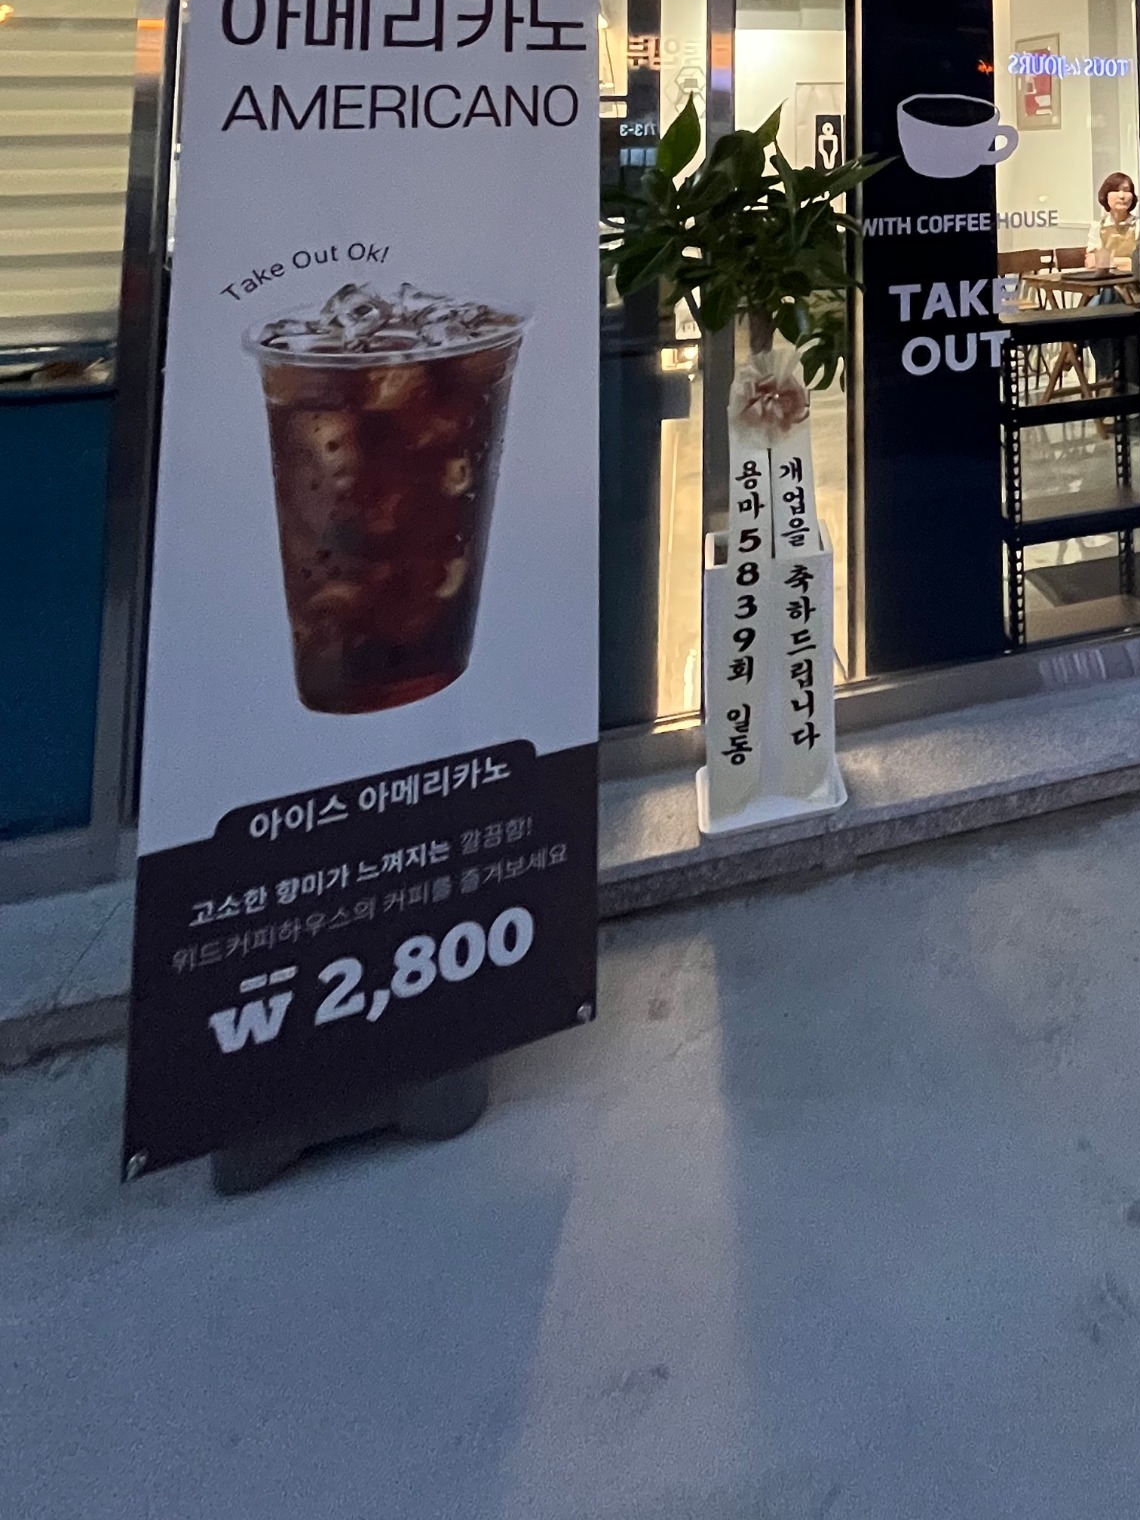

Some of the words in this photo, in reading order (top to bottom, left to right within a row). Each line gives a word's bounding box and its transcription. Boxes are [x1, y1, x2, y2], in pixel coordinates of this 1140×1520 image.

[221, 84, 580, 132] AMERICANO
[862, 216, 912, 237] WITH
[917, 212, 992, 235] COFFEE
[996, 209, 1059, 230] HOUSE
[220, 262, 286, 301] Take
[292, 245, 338, 269] Out
[347, 242, 390, 264] Ok!
[888, 277, 1020, 322] TAKE
[902, 329, 1011, 376] OUT
[779, 456, 811, 547] 개업을
[784, 564, 821, 751] 축하드립니다
[721, 703, 754, 766] 일동
[249, 795, 349, 842] 아이스
[358, 755, 512, 815] 아메리카노
[188, 883, 268, 927] 고소한
[275, 863, 350, 905] 향미가
[356, 840, 450, 883] 느껴지는
[172, 895, 376, 974] 위드커피하우스의
[314, 906, 535, 1025] 2,800
